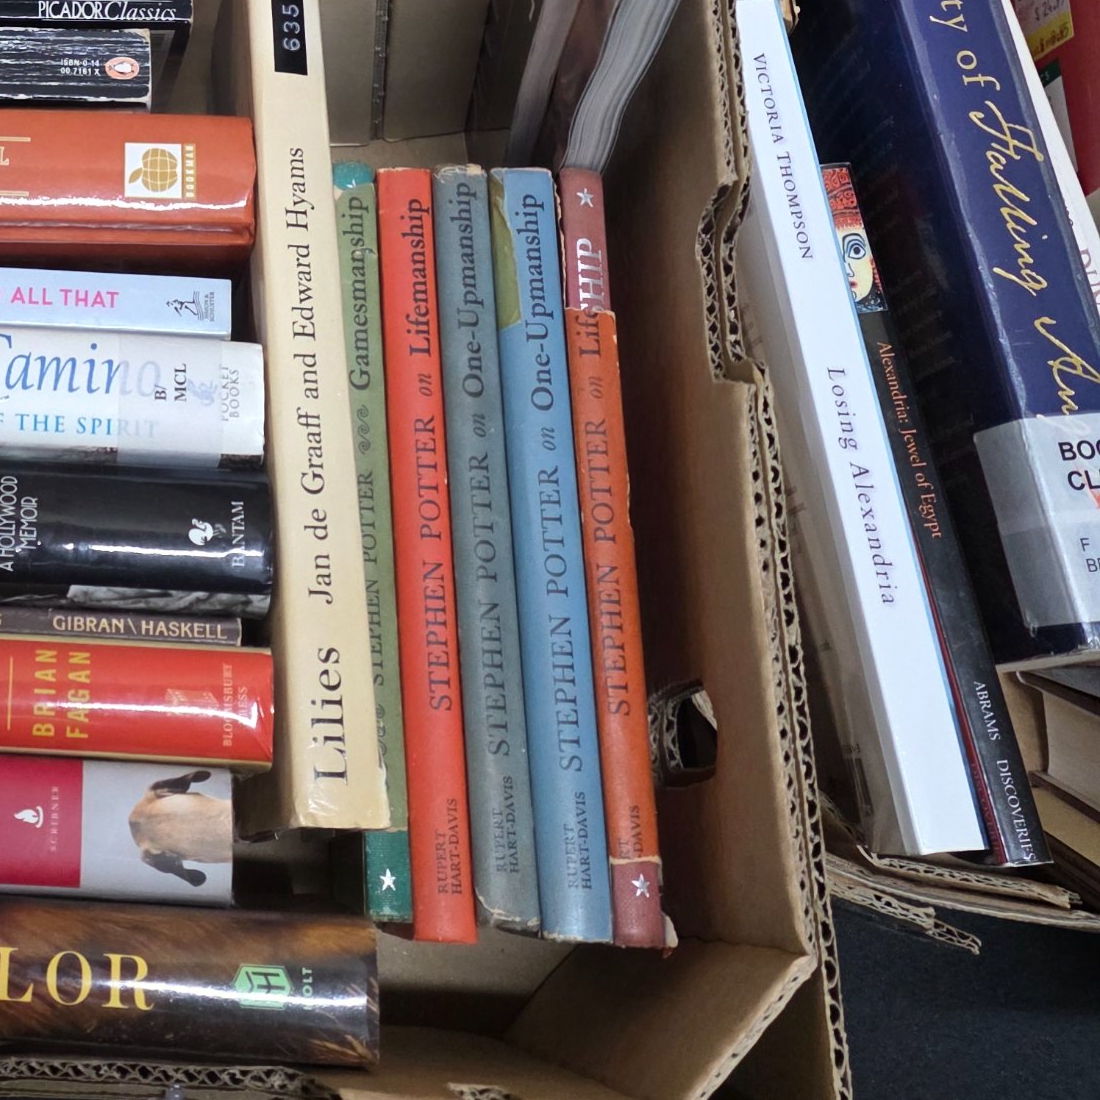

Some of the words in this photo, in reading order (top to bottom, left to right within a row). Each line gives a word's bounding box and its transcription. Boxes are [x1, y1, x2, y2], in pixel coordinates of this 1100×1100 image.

[282, 3, 300, 51] 635
[956, 50, 1001, 91] of
[286, 147, 315, 231] Hyams
[754, 53, 783, 144] VICTORIA
[776, 152, 813, 260] THOMPSON
[11, 286, 53, 306] ALL
[60, 289, 120, 309] THAT
[289, 244, 317, 341] Edward
[401, 198, 432, 358] Lifemanship
[516, 193, 554, 412] One-Upmanship
[173, 363, 188, 402] MCL
[293, 351, 319, 399] and
[422, 372, 433, 397] on
[876, 341, 909, 424] Alexandria:
[15, 414, 66, 433] THE
[77, 417, 157, 438] SPIRIT
[297, 408, 325, 495] Graaff
[541, 426, 555, 451] on
[899, 428, 927, 468] Jewel
[415, 415, 442, 542] POTTER
[827, 366, 858, 451] Losing
[850, 461, 896, 605] Alexandria
[915, 471, 931, 487] of
[919, 491, 943, 539] Egypt
[19, 497, 38, 550] MEMOIR
[231, 501, 246, 568] BANTAM
[303, 508, 329, 542] de
[539, 465, 569, 599] POTTER
[2, 560, 15, 573] A
[309, 554, 334, 604] Jan
[52, 615, 126, 634] GIBRAN
[142, 621, 227, 640] HASKELL
[423, 560, 453, 711] STEPHEN
[33, 649, 58, 738] BRIAN
[66, 651, 92, 739] FAGAN
[310, 647, 348, 787] Lilies
[548, 614, 583, 772] STEPHEN
[974, 681, 1000, 741] ABRAMS
[996, 759, 1037, 862] DISCOVERIES
[447, 798, 462, 895] HART-DAVIS
